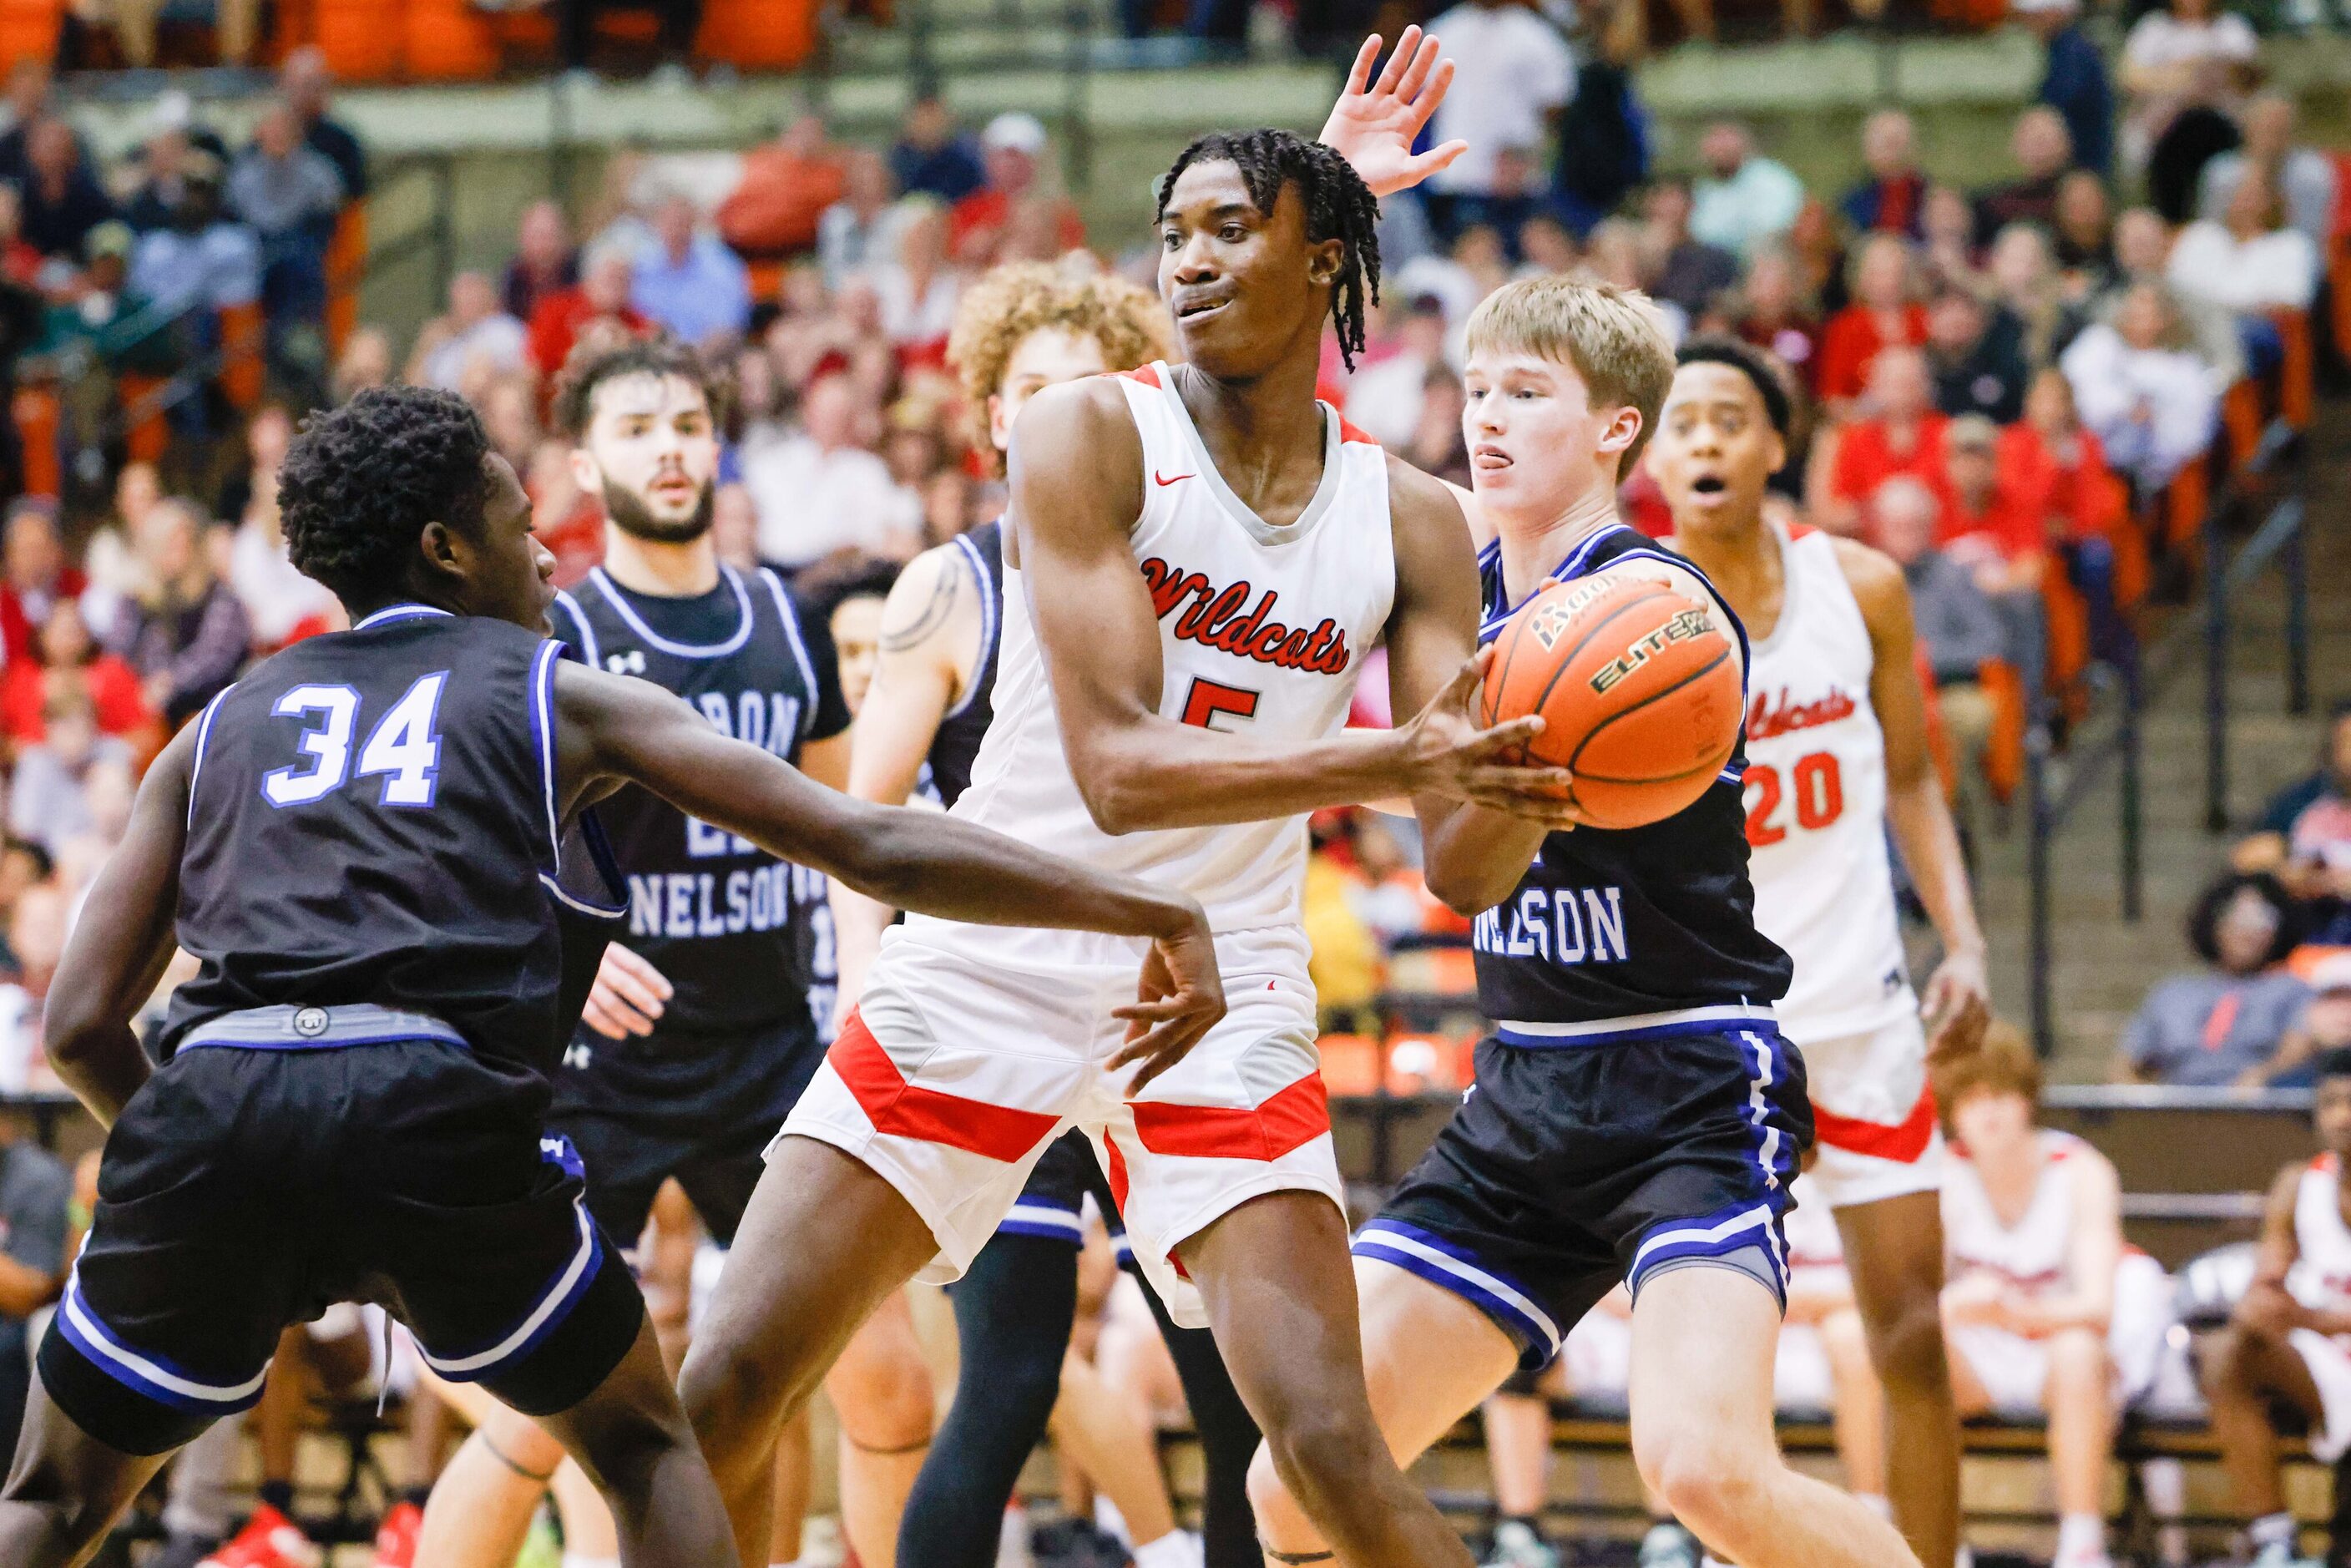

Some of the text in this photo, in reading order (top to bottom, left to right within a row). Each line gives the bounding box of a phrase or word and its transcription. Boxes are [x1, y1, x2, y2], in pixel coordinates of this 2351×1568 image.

[1140, 558, 1350, 675] Wildcats
[1589, 618, 1691, 696] ELITE
[260, 670, 450, 809] 34
[680, 691, 799, 759] RON
[1742, 752, 1843, 847] 20
